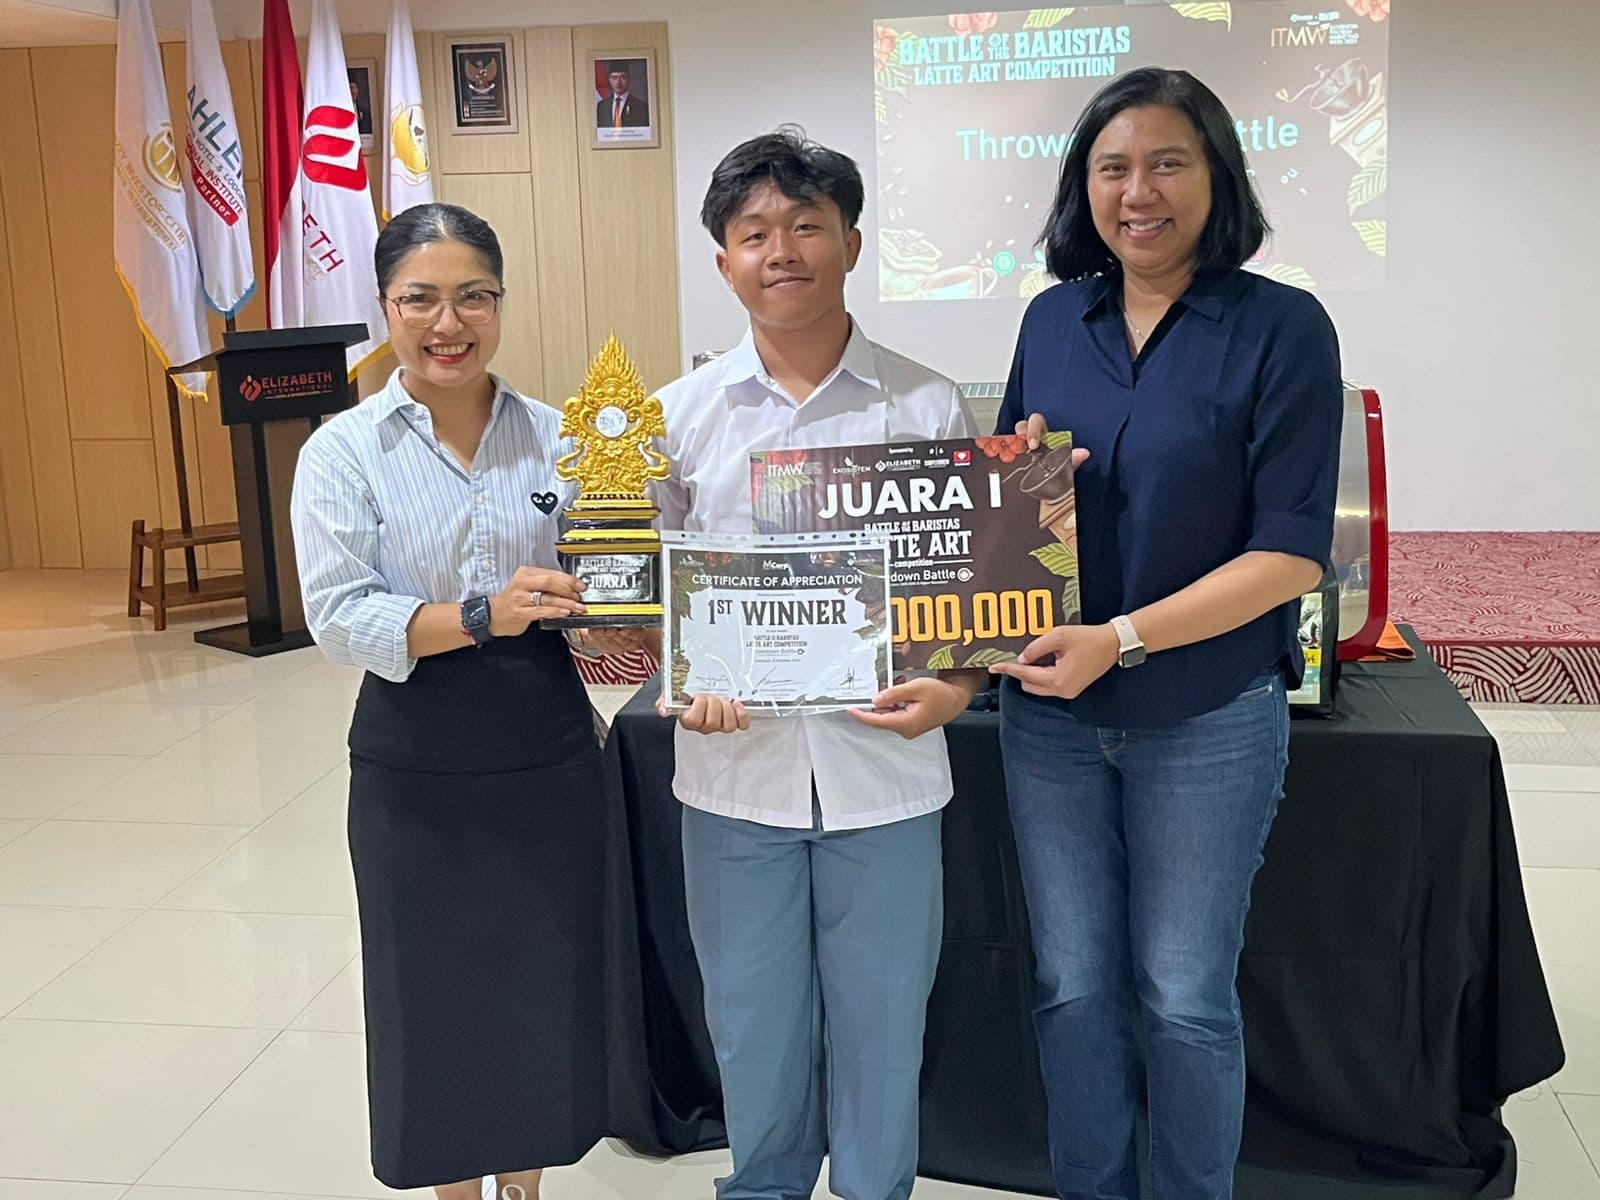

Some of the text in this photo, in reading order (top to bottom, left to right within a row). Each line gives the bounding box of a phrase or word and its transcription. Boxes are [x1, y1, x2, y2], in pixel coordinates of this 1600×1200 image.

[900, 35, 984, 65] BATTLE
[1015, 26, 1130, 59] BARISTAS
[914, 56, 1116, 86] LATTE ART COMPETITION
[196, 176, 231, 216] Partner
[262, 371, 333, 389] ELIZABETH
[818, 476, 974, 519] JUARA
[864, 521, 901, 534] BATTLE
[912, 518, 961, 532] BARISTAS
[889, 530, 972, 559] TE ART
[589, 575, 629, 588] JUARA
[691, 573, 864, 587] CERTIFICATE OF APPRECIATION
[923, 568, 957, 581] Battle
[708, 599, 848, 626] 1ST WINNER
